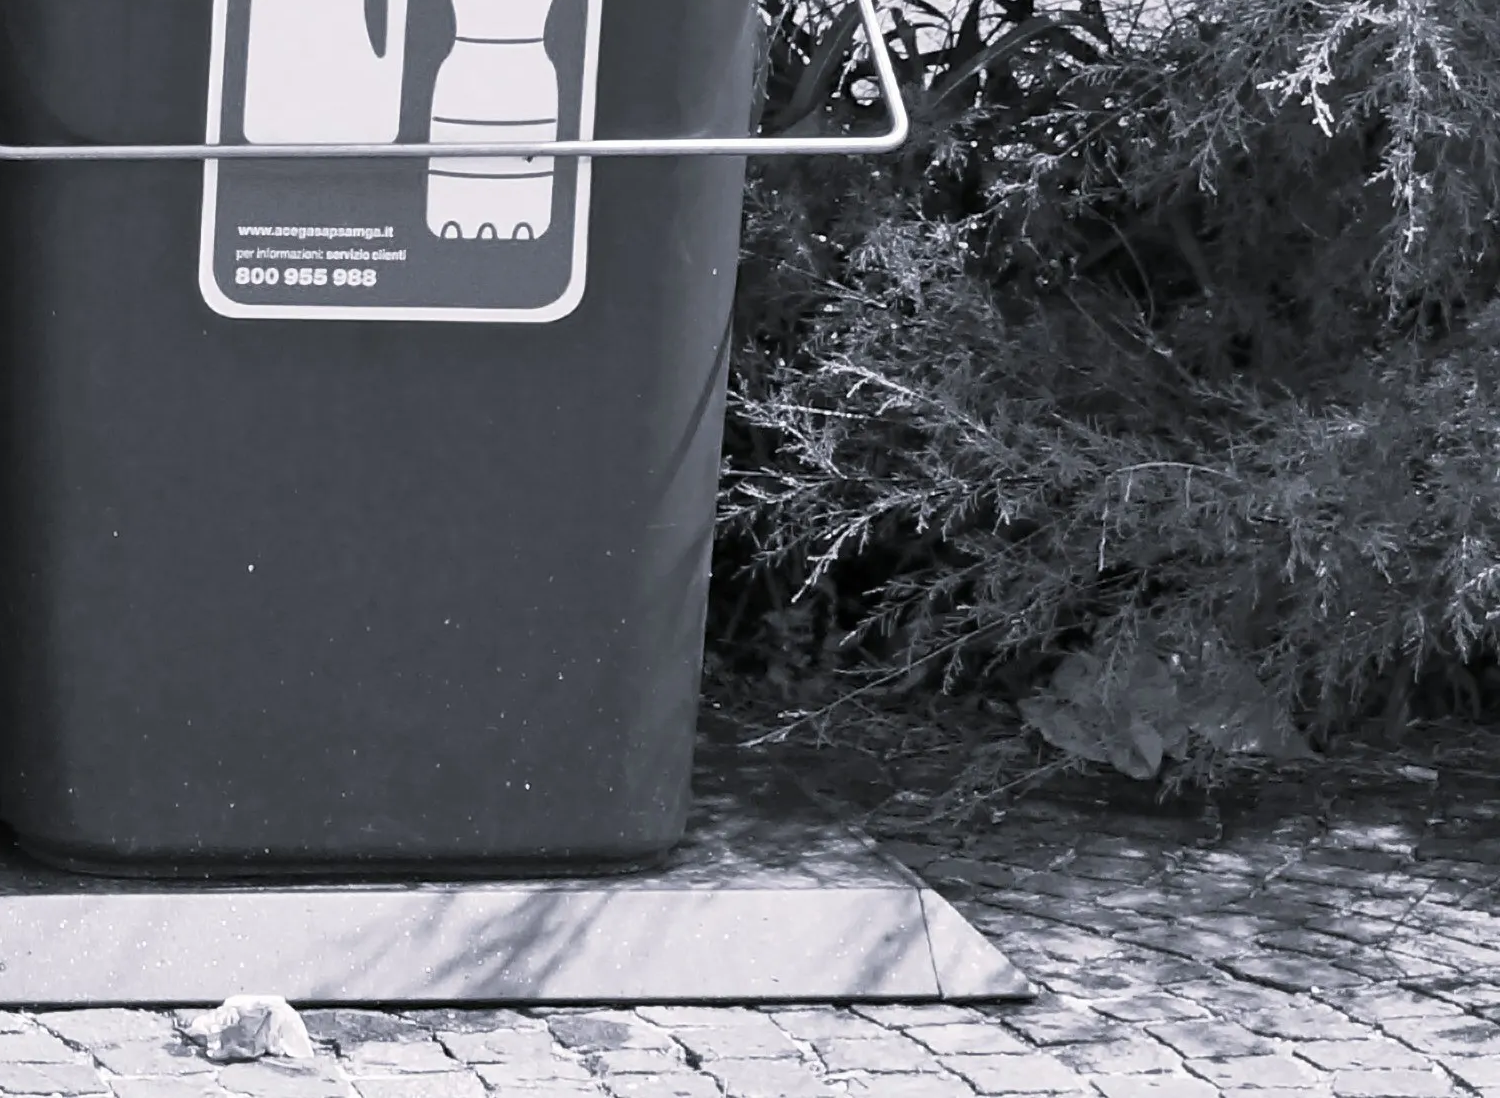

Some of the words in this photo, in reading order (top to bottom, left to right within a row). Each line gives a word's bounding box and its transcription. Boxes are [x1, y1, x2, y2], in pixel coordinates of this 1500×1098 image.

[326, 249, 370, 261] servizio
[371, 249, 406, 261] clienti
[235, 267, 280, 285] 800
[283, 267, 328, 286] 955
[333, 268, 377, 286] 988
